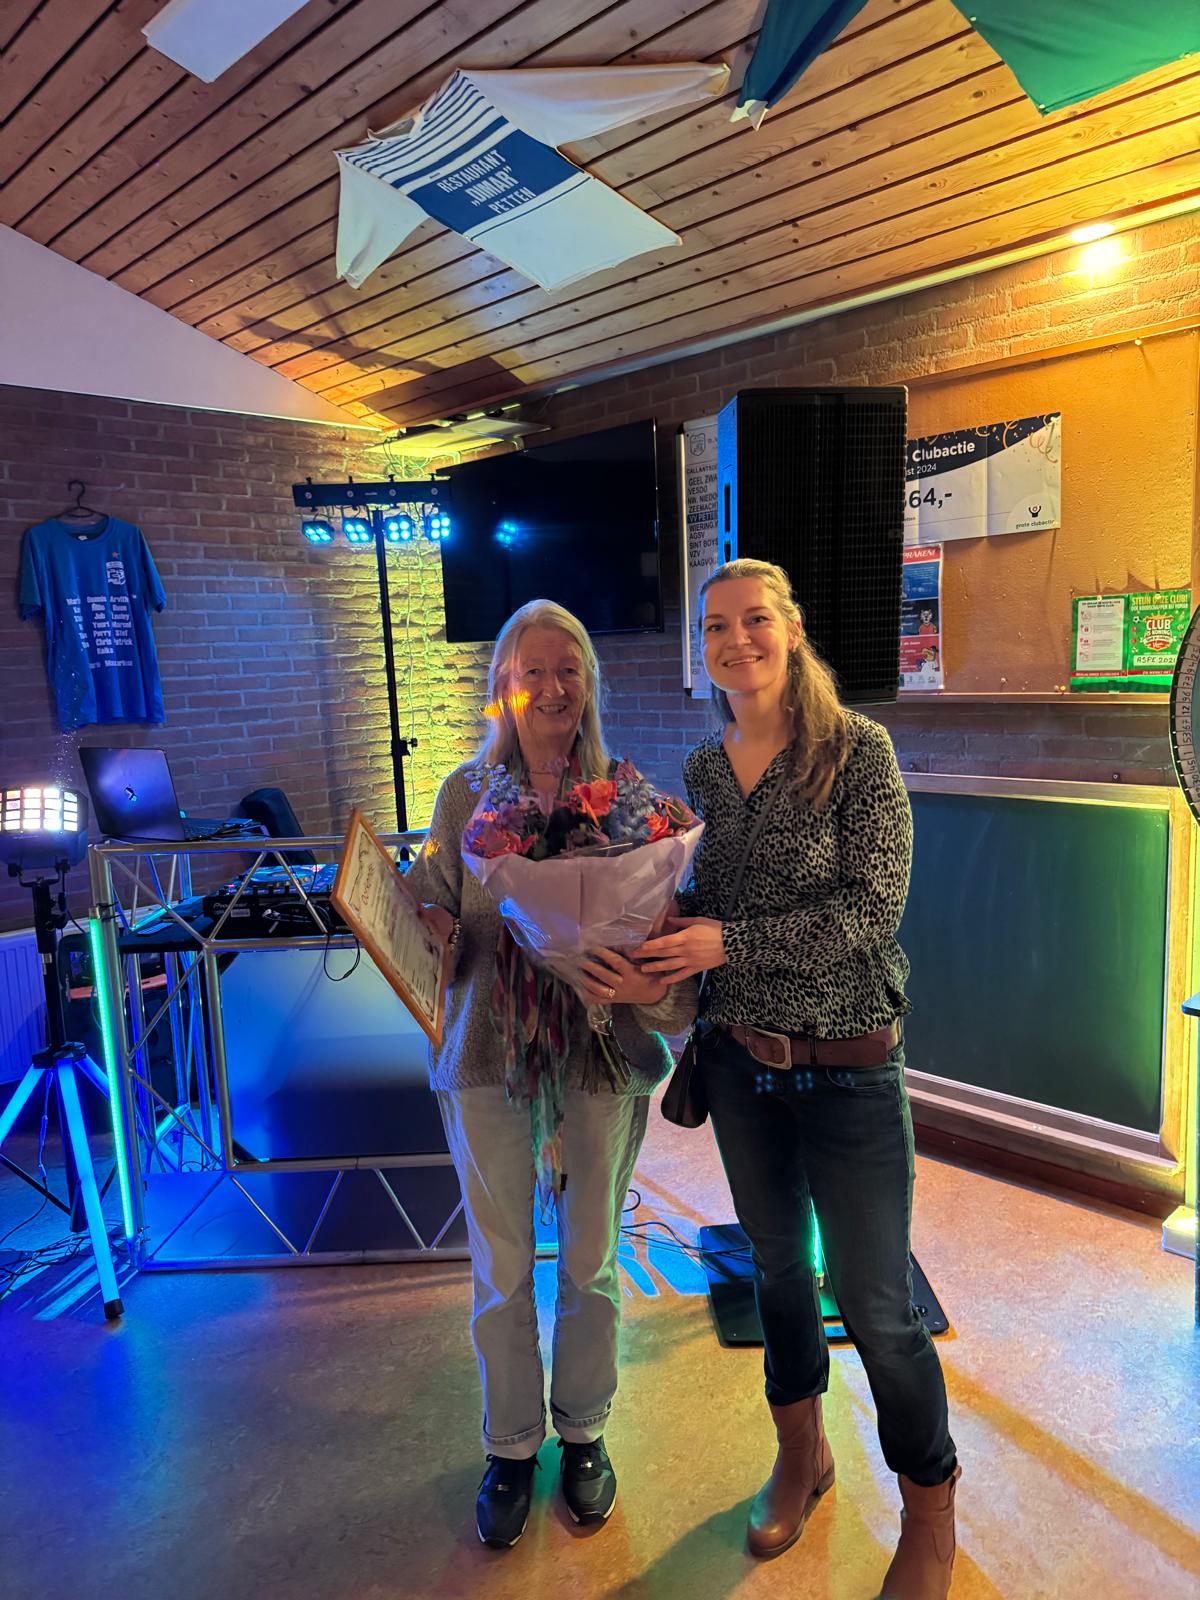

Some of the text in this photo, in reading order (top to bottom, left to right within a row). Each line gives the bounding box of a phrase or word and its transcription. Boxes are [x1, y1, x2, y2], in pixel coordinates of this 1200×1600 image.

[437, 149, 506, 193] RESTAURANT
[488, 187, 536, 214] PETTEN
[912, 441, 976, 462] Clubactie
[916, 463, 937, 474] 2024
[689, 474, 717, 487] GEEL ZWA
[700, 493, 717, 502] NIEDO
[1146, 619, 1171, 630] CLUB
[1182, 705, 1190, 715] 12
